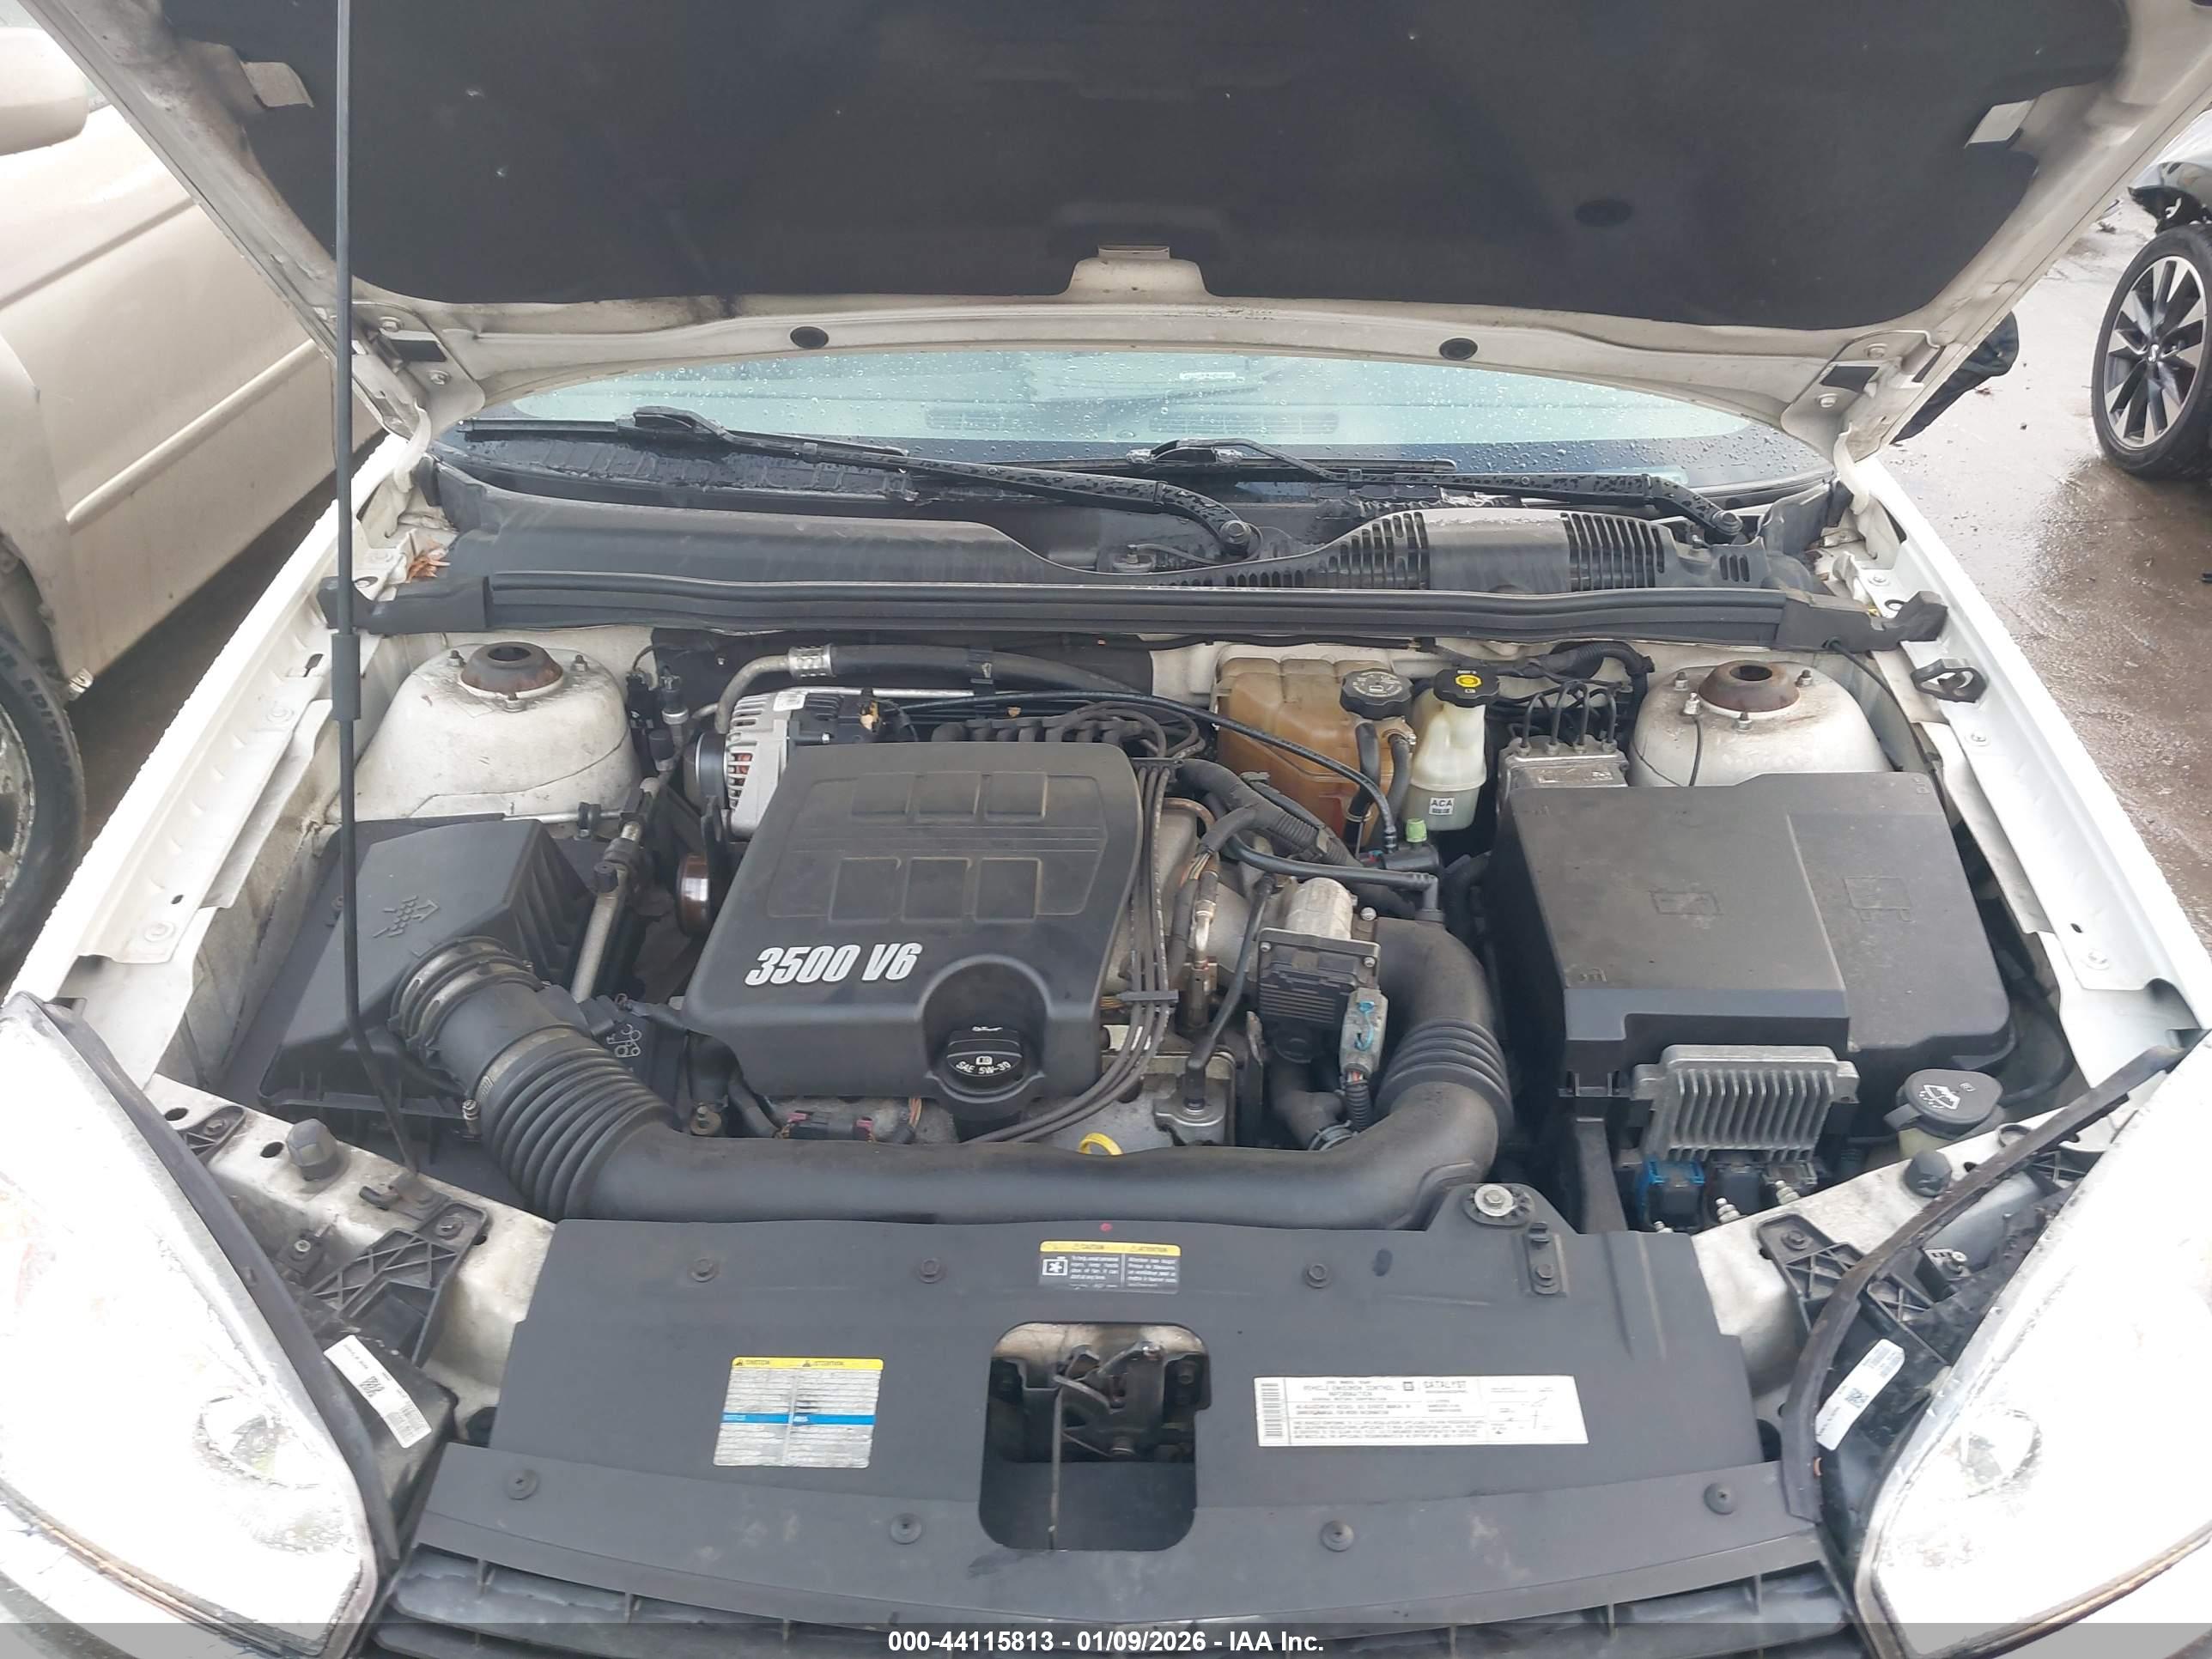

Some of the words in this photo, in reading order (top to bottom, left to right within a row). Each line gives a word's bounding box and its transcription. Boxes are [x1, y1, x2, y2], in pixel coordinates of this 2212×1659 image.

[744, 945, 861, 986] 3500
[861, 943, 923, 981] V6
[956, 1060, 975, 1073] SAE
[978, 1060, 1012, 1074] 5W-30
